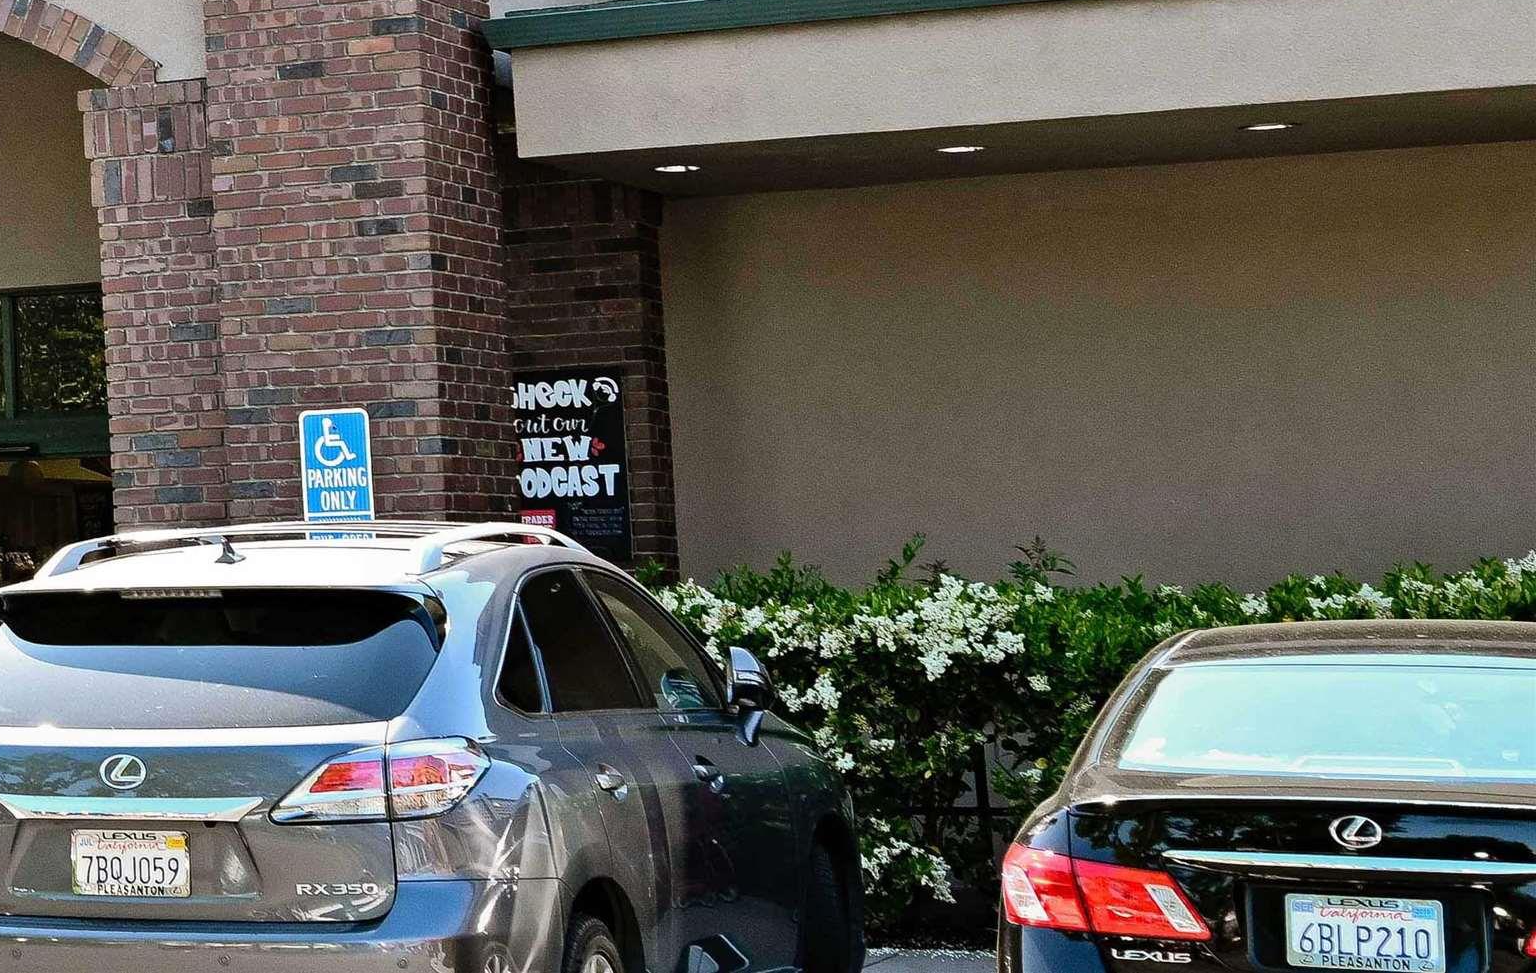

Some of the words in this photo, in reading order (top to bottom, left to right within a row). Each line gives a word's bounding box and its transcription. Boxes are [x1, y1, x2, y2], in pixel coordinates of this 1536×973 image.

[513, 413, 551, 434] out
[520, 435, 592, 463] NEW
[307, 466, 368, 489] PARKING
[516, 464, 620, 498] ODCAST
[320, 490, 357, 511] ONLY
[102, 832, 157, 841] LEXUS
[81, 855, 180, 885] 7BQJ059
[97, 884, 165, 896] PLEASANTON
[295, 883, 331, 896] RX
[331, 883, 380, 895] 350
[1327, 898, 1400, 909] LEXUS
[1319, 907, 1414, 924] California
[1299, 922, 1431, 960] 6BLP210
[1110, 947, 1192, 964] LEXUS
[1322, 955, 1411, 971] PLEASANTON
